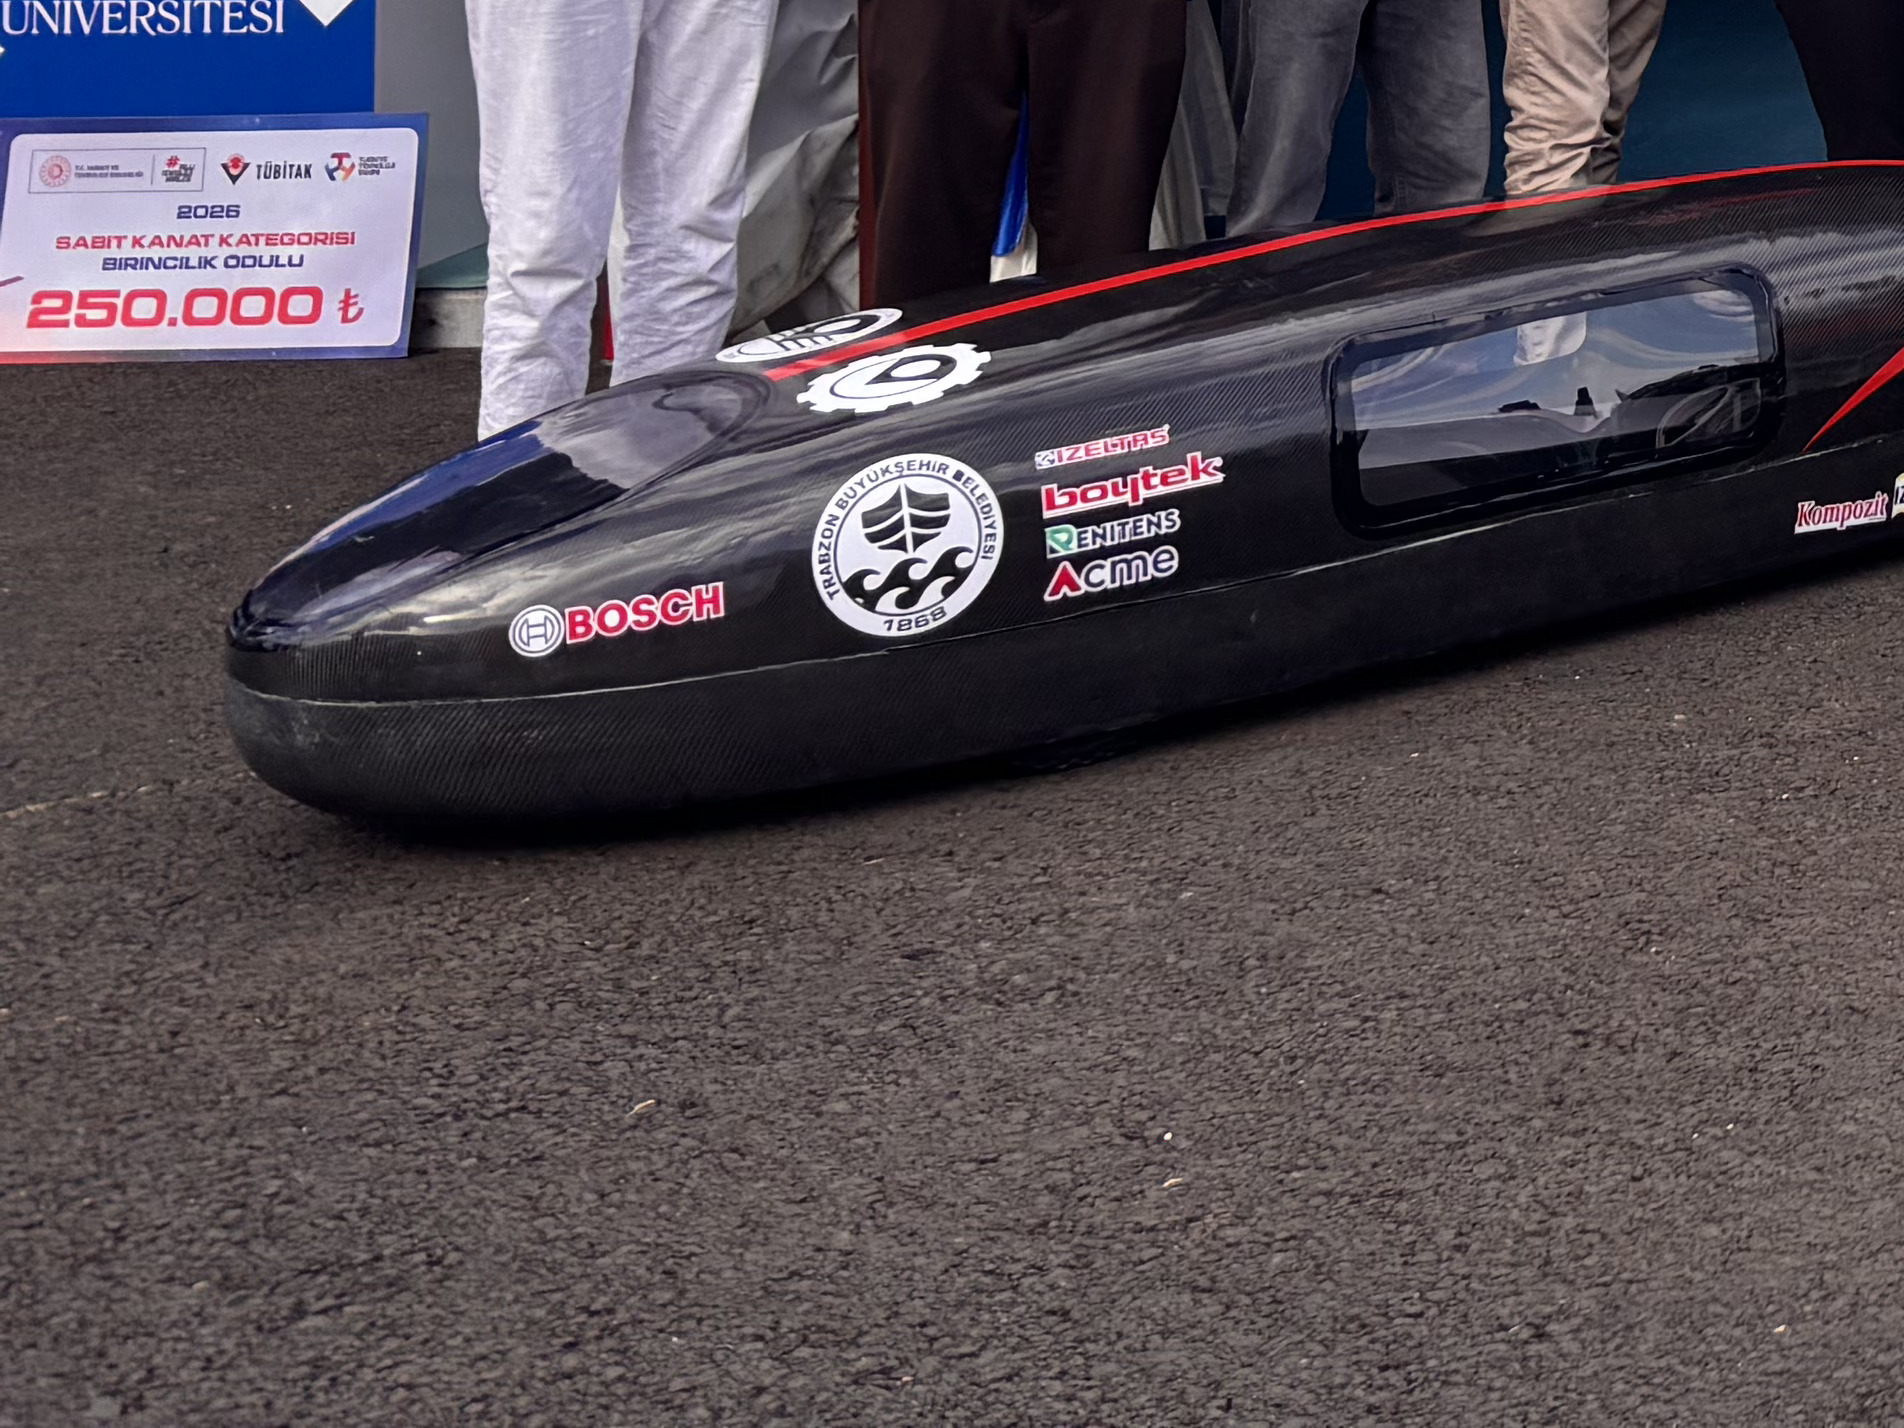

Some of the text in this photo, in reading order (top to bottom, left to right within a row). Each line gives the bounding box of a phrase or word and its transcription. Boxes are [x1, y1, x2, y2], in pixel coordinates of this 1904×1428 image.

[256, 160, 313, 181] TÜBİTAK
[176, 204, 241, 219] 2026
[132, 233, 214, 249] KANAT
[26, 286, 323, 328] 250.000
[1044, 453, 1220, 513] boytek
[1796, 491, 1888, 530] Kompozit
[817, 514, 841, 601] TRABZON
[565, 582, 724, 644] BOSCH
[883, 606, 948, 633] 1868
